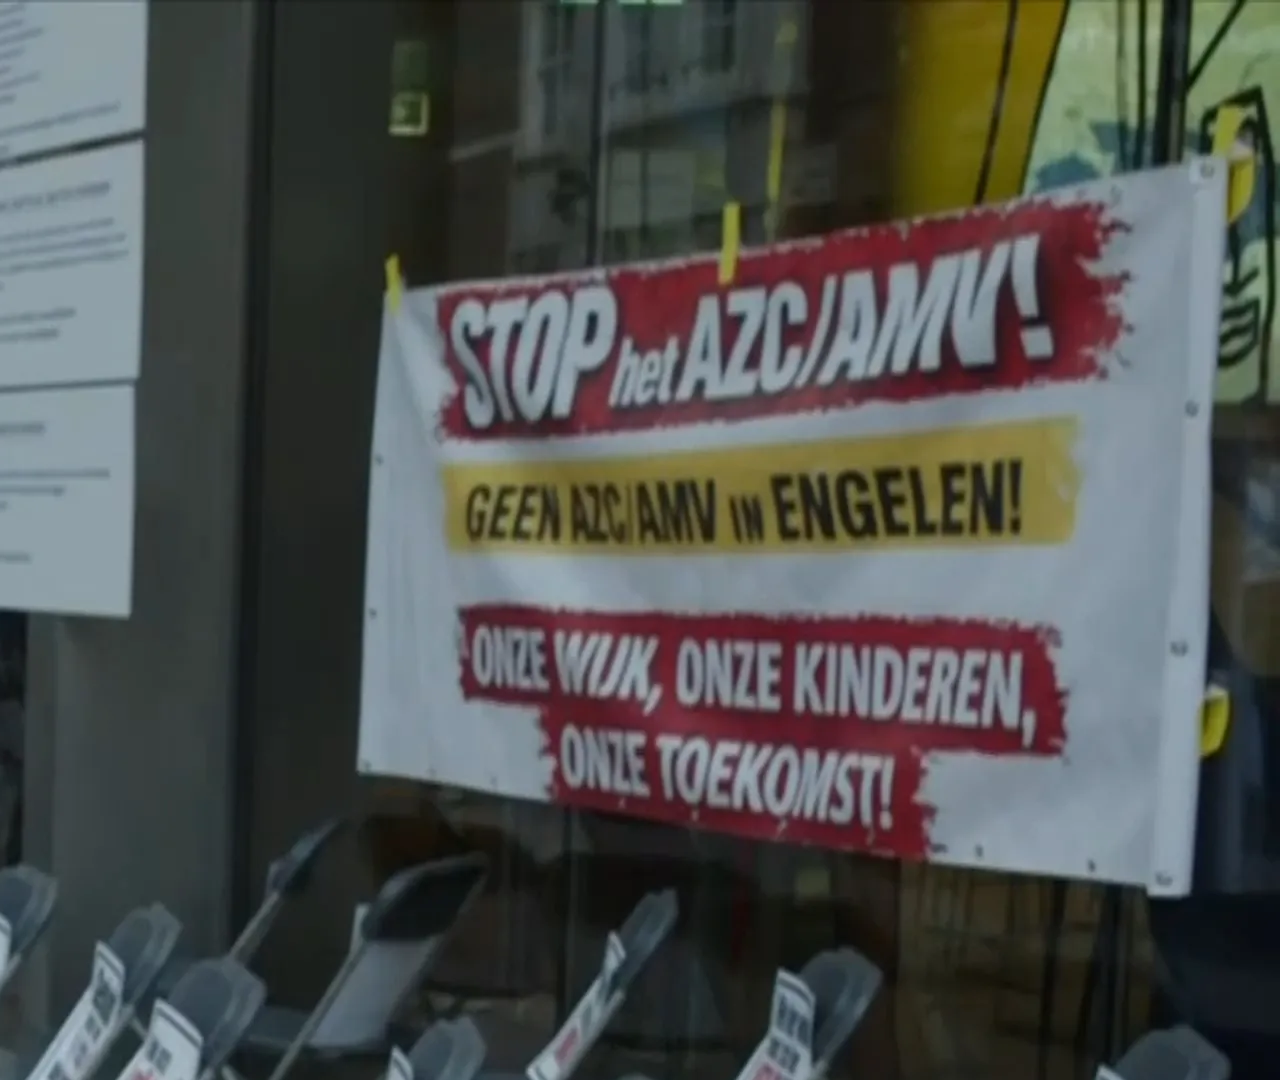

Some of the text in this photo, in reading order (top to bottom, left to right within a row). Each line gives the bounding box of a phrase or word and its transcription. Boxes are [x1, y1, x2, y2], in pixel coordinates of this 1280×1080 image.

[451, 234, 1054, 429] STOP het AZC/AMV!
[465, 483, 562, 544] GEEN
[570, 478, 716, 545] AZC/AMV
[771, 458, 1024, 541] ENGELEN!
[471, 625, 1037, 748] ONZE WIJK, ONZE KINDEREN,
[560, 723, 895, 830] ONZE TOEKOMST!
